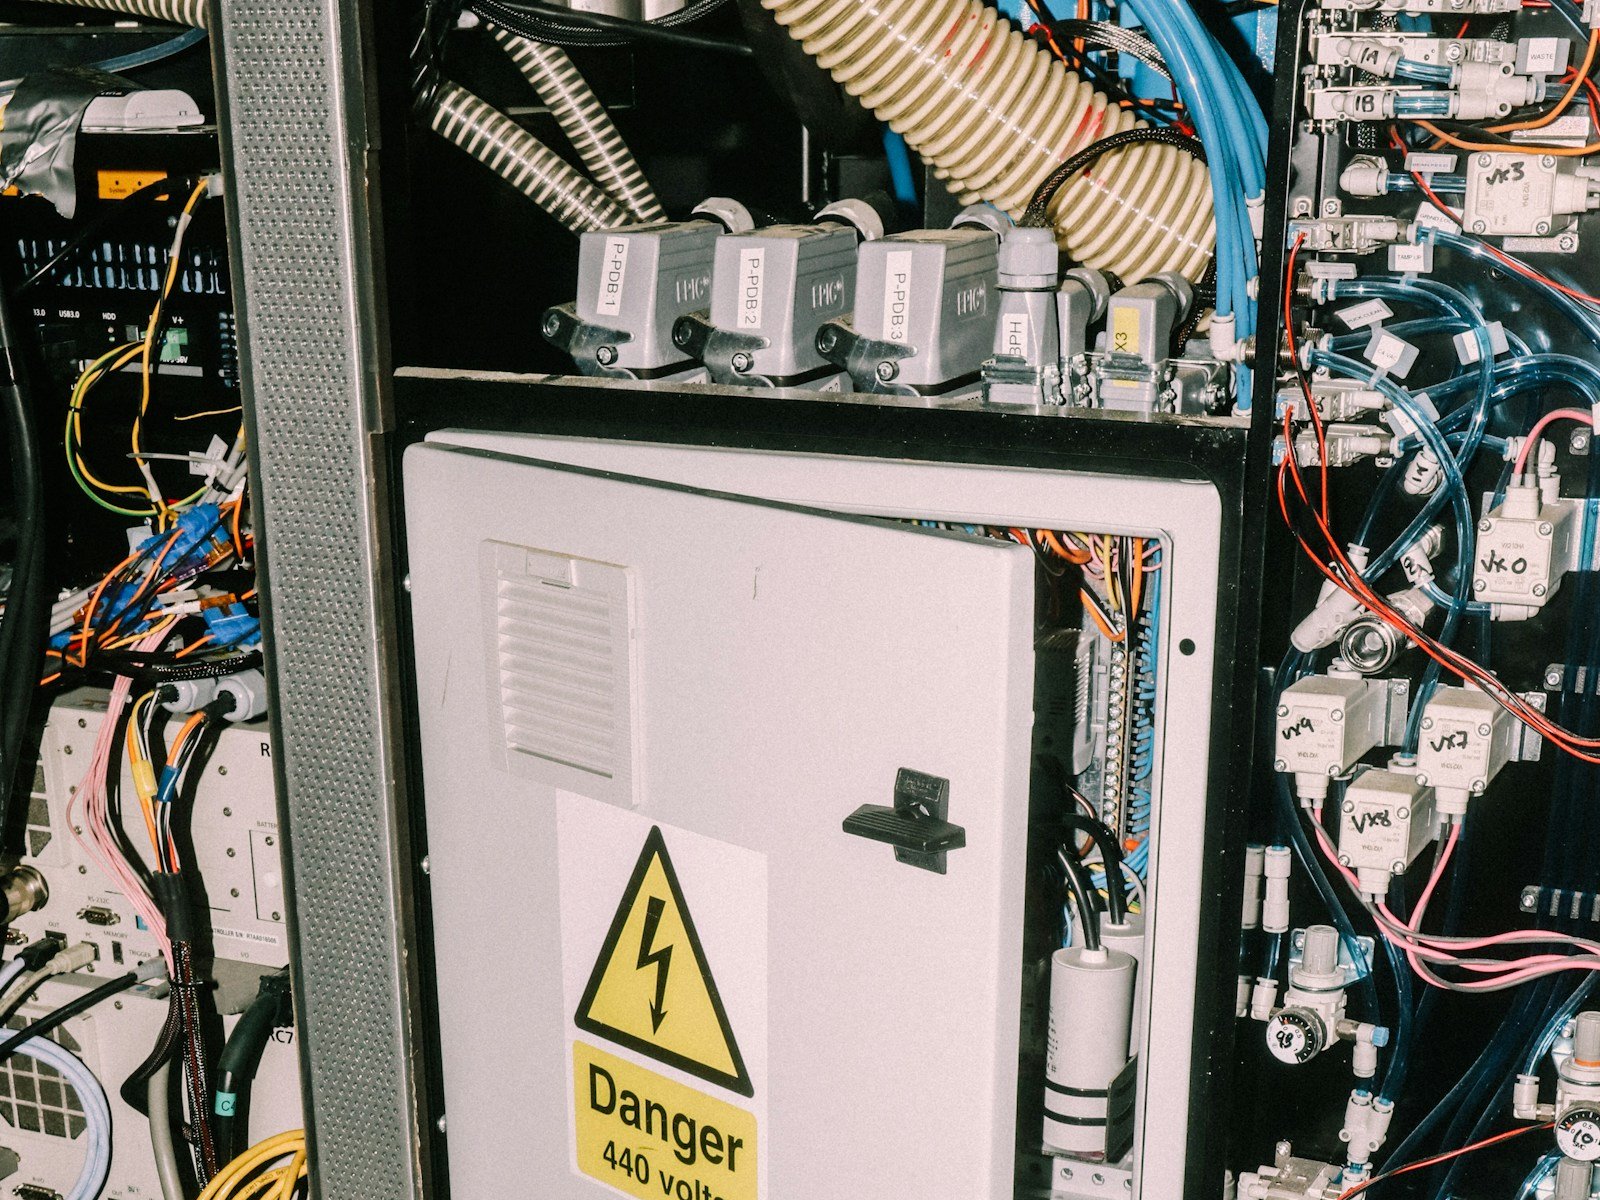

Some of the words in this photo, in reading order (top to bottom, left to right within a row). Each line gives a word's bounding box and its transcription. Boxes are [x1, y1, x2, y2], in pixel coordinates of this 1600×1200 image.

[1360, 47, 1379, 65] 1A
[1355, 94, 1374, 112] 1B
[604, 242, 624, 307] P-PDB:1
[744, 257, 760, 325] P-PDB:2
[59, 310, 80, 319] USB3.0
[890, 272, 906, 340] P-PDB:3
[102, 312, 117, 321] HDD
[1115, 332, 1128, 352] X3
[256, 820, 279, 830] BATTER
[103, 930, 129, 939] MEMORY
[128, 949, 151, 958] TRIGGER
[270, 1029, 294, 1044] C7
[589, 1062, 744, 1173] Danger
[602, 1139, 650, 1185] 440
